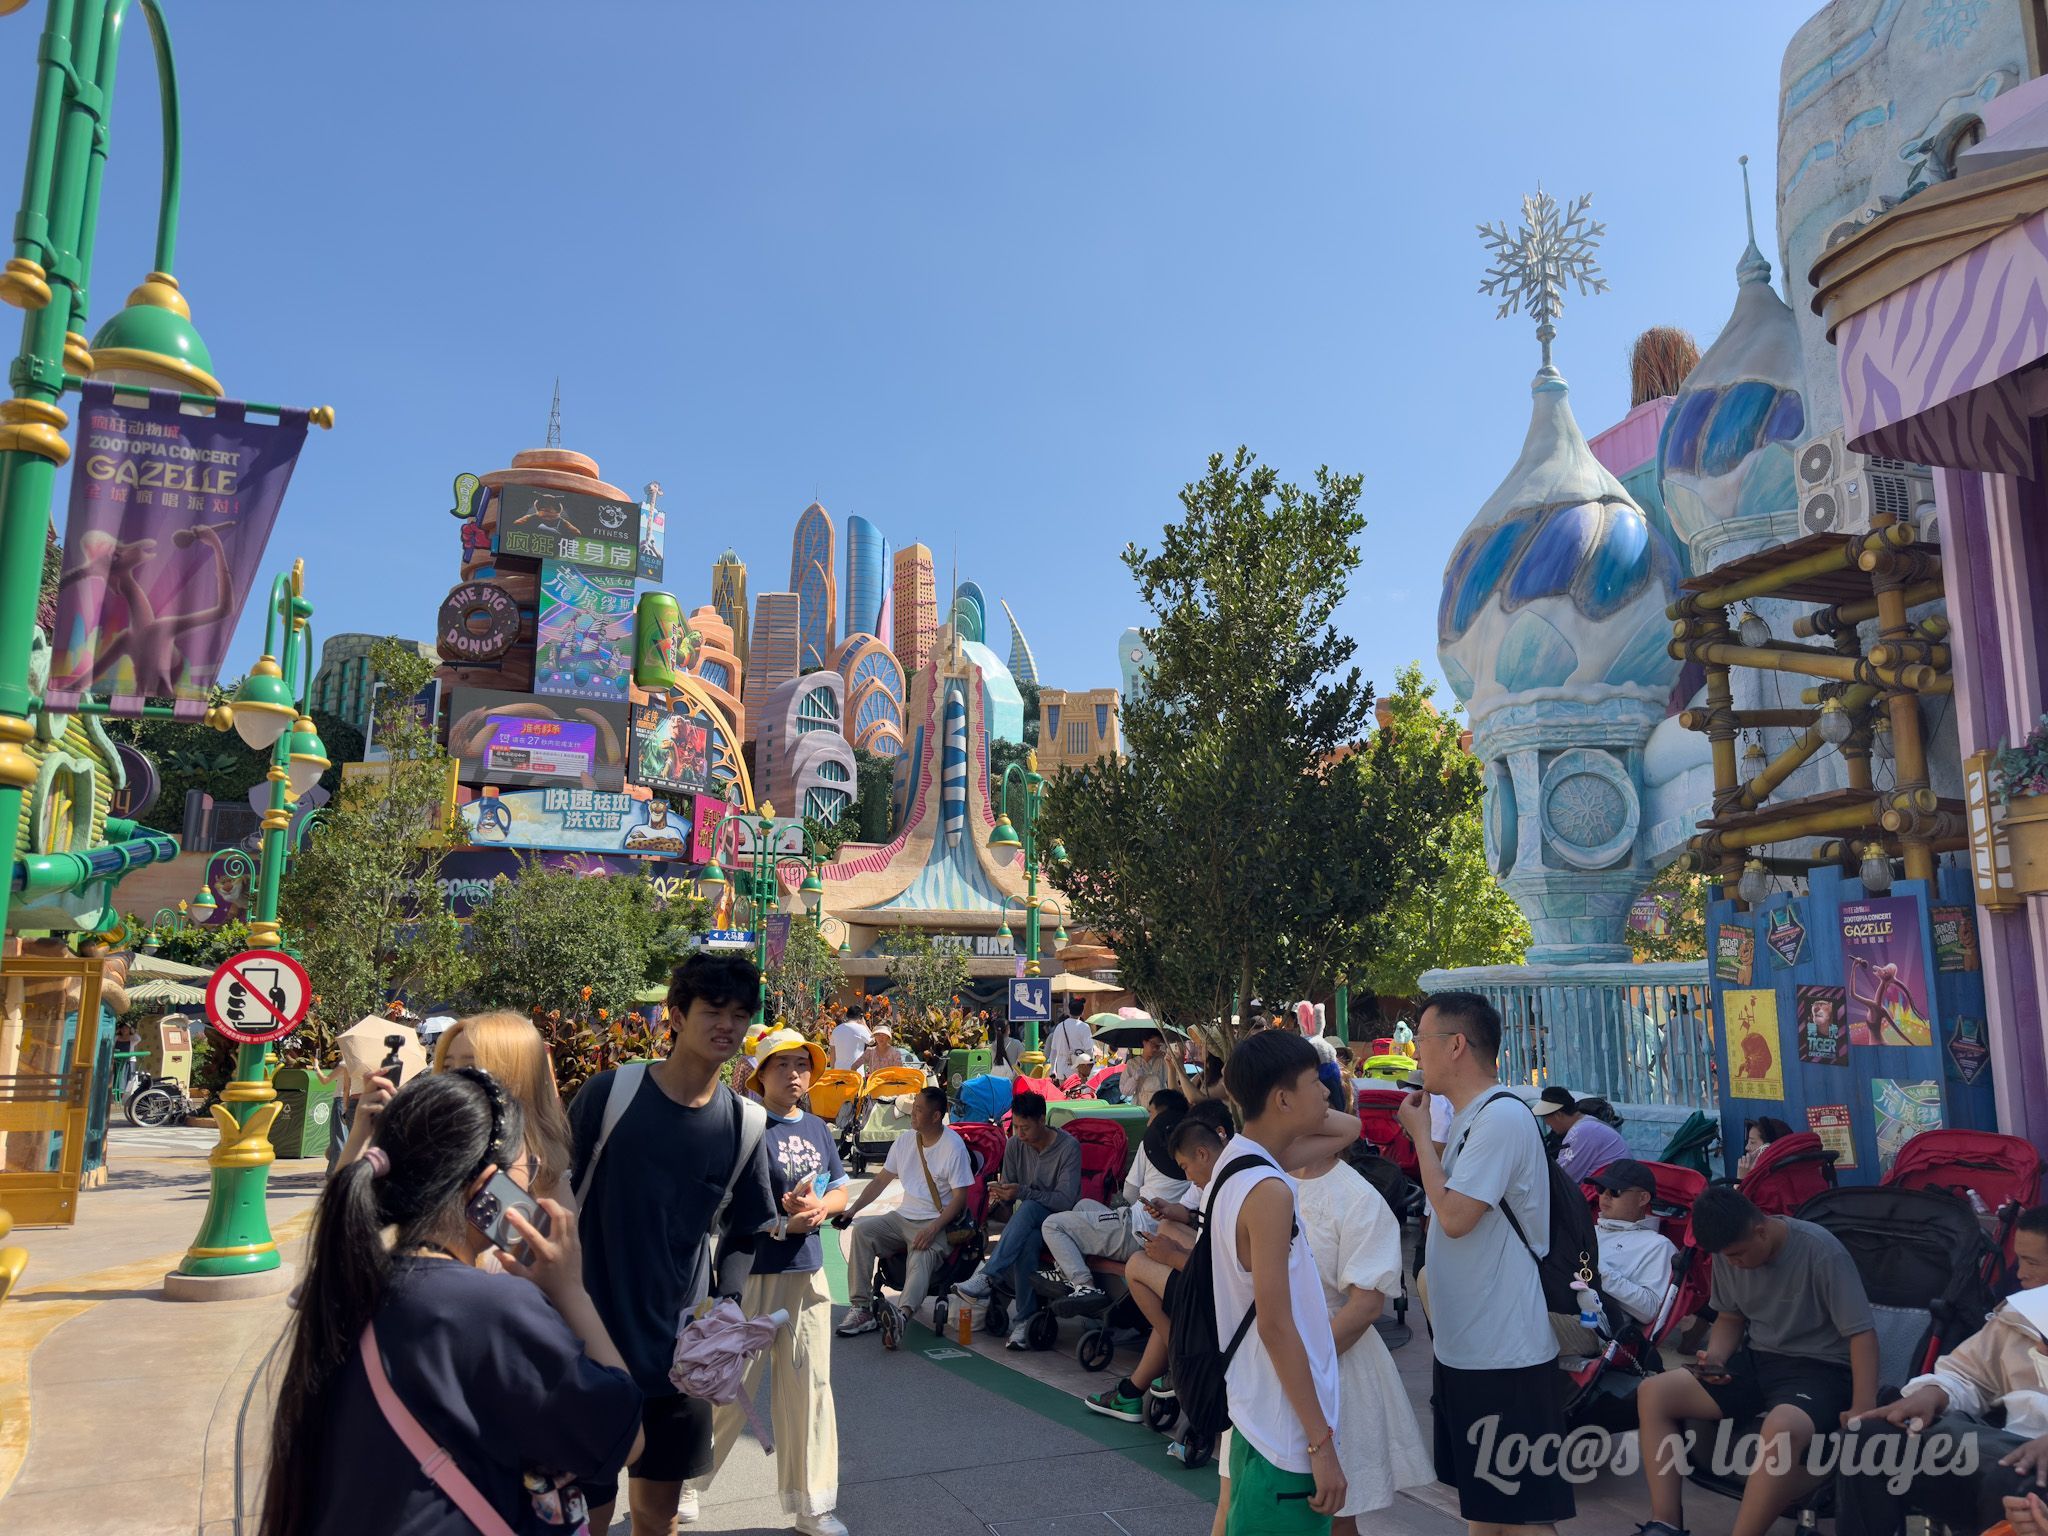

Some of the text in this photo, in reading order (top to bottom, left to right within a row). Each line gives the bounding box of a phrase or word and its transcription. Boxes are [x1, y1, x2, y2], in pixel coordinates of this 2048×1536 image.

[91, 415, 181, 439] 疯狂动物城
[89, 435, 240, 466] ZOOTOPIA CONCERT
[86, 455, 238, 495] GAZELLE
[593, 527, 629, 540] FITNESS
[506, 530, 631, 567] 疯狂健身房
[448, 587, 508, 611] THE BIG
[446, 628, 504, 652] DONUT
[527, 735, 540, 745] 27
[545, 789, 631, 812] 快速祛斑
[564, 811, 621, 829] 洗衣液
[1868, 912, 1892, 922] CONCERT
[723, 931, 745, 941] 大马路
[1843, 921, 1893, 938] GAZELLE
[976, 936, 1017, 956] HALL
[1807, 1037, 1837, 1052] TIGER
